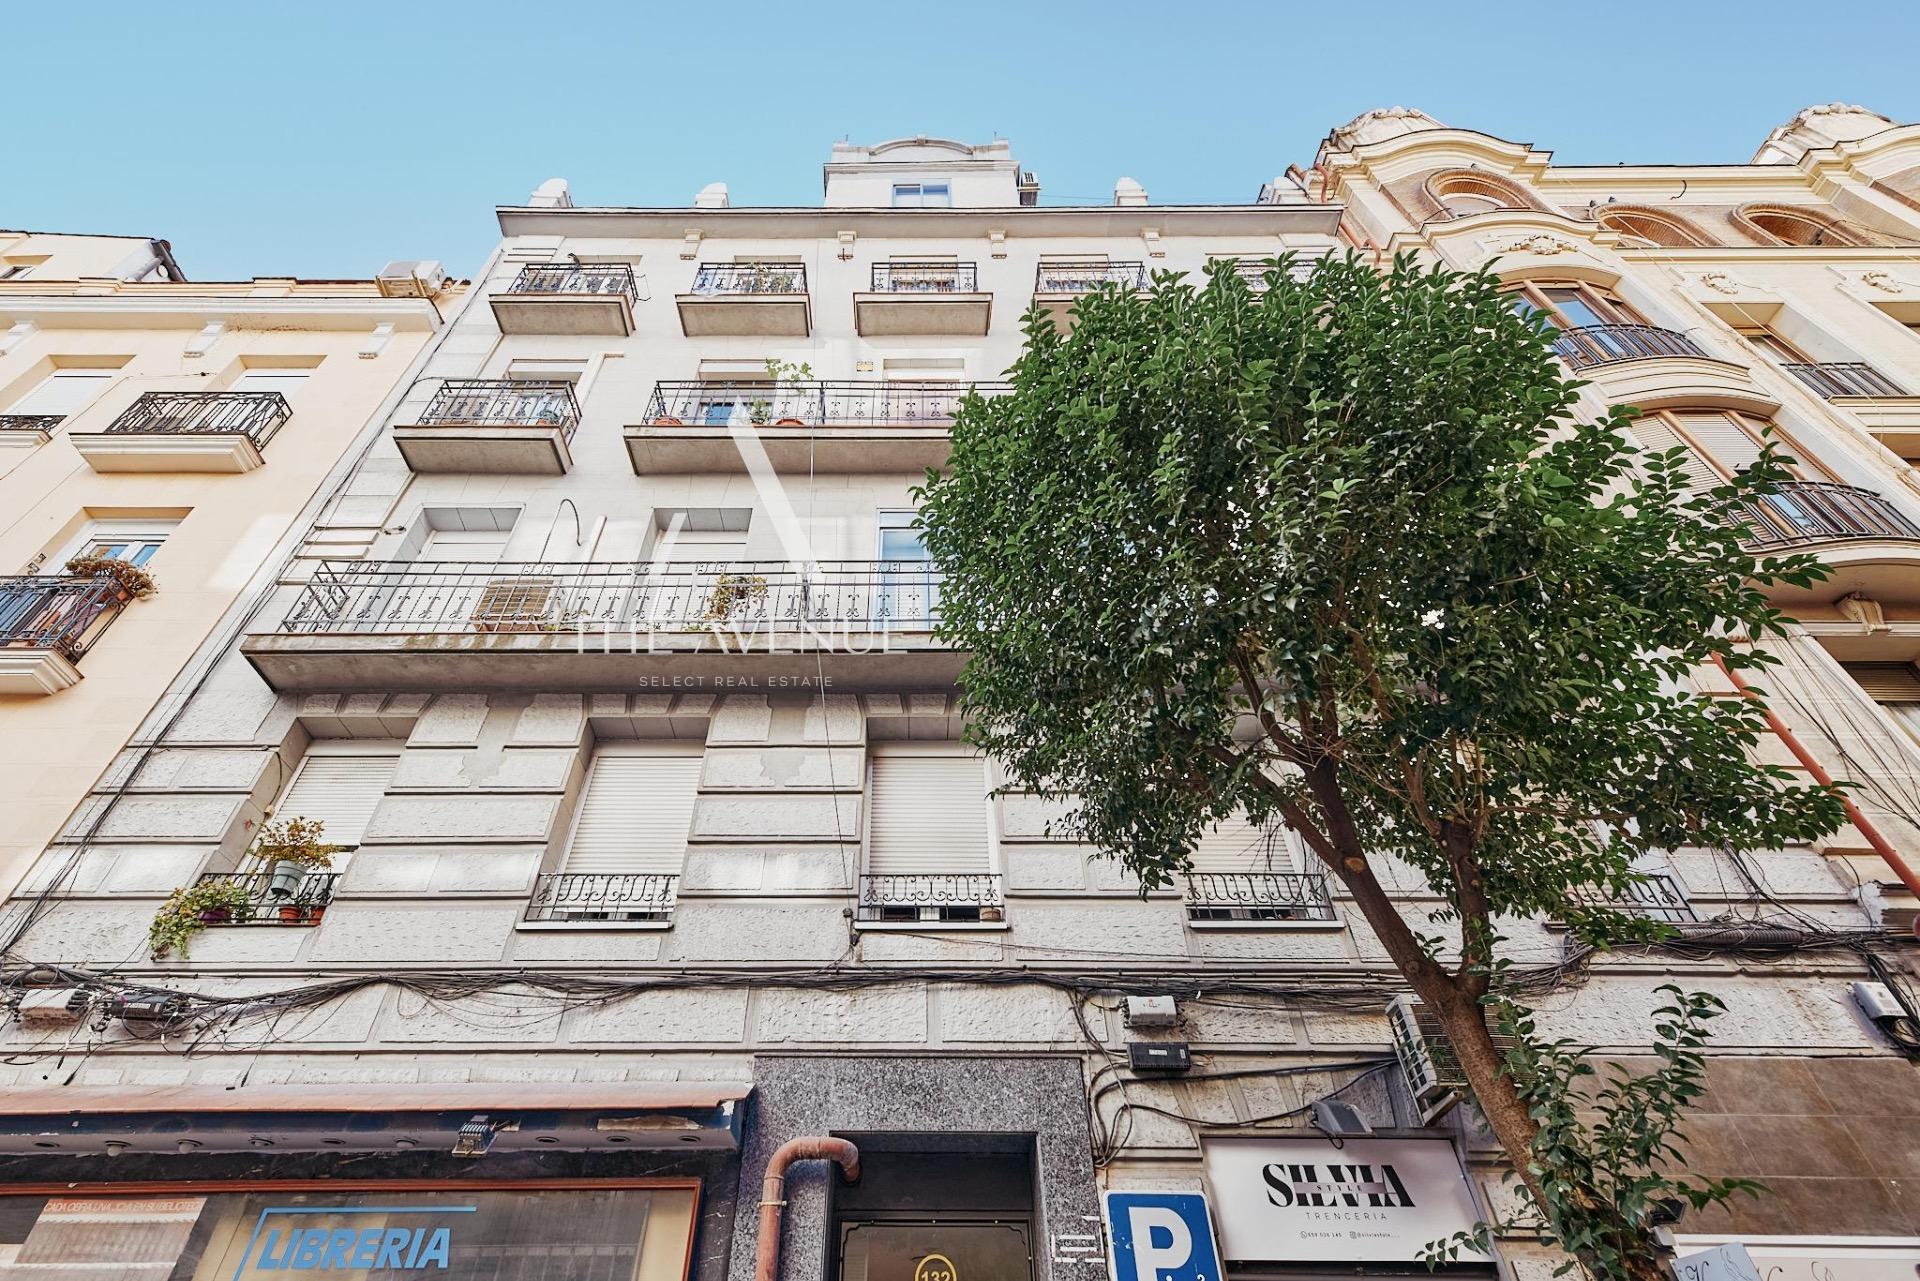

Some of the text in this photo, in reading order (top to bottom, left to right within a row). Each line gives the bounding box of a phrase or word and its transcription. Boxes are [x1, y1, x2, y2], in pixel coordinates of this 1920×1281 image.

[1262, 1163, 1417, 1208] SILVIA
[256, 1228, 450, 1269] LIBRERIA
[1128, 1206, 1193, 1281] P
